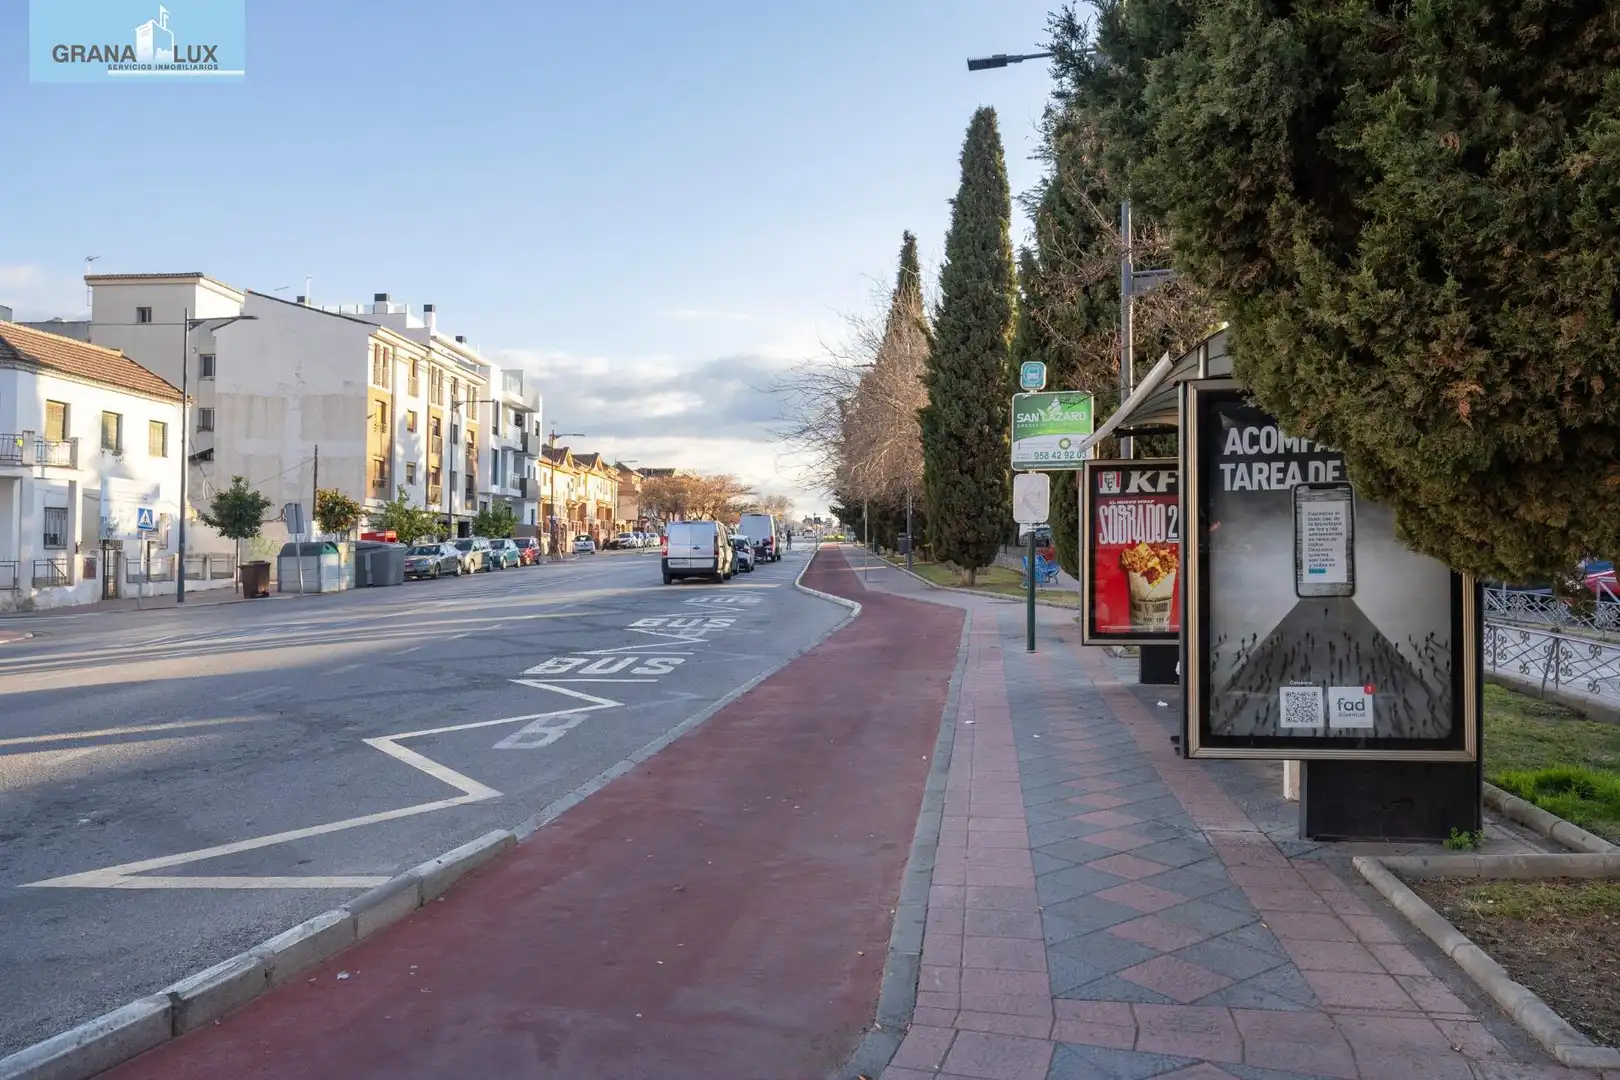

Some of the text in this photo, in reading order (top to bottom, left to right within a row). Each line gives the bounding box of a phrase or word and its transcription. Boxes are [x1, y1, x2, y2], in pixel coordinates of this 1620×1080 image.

[1017, 412, 1039, 423] SAN
[1033, 451, 1049, 460] 958
[1051, 451, 1062, 460] 42
[1064, 450, 1075, 459] 92
[1076, 450, 1087, 460] 03
[1126, 470, 1179, 493] KF
[1219, 460, 1341, 491] TAREA DE
[520, 656, 687, 676] BUS
[1337, 697, 1366, 712] fad
